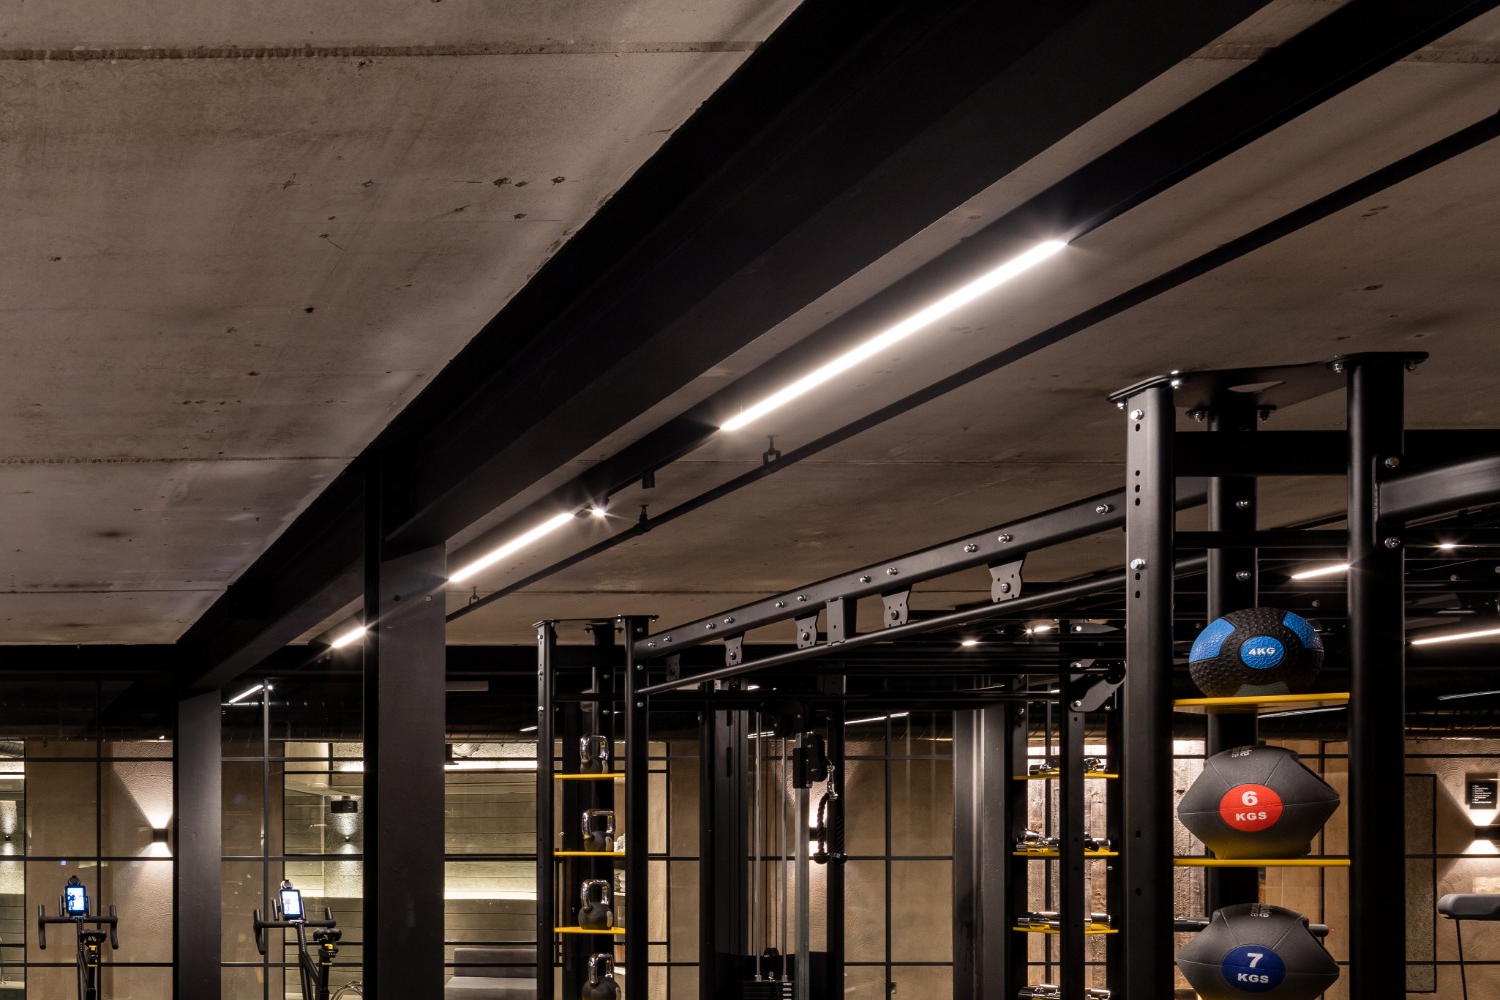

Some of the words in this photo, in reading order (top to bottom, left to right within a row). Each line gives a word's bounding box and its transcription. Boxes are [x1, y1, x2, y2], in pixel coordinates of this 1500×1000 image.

[1248, 647, 1275, 656] 4KG
[1241, 791, 1258, 806] 6
[1235, 811, 1267, 821] KGS
[1247, 952, 1264, 968] 7
[1237, 972, 1269, 984] KGS
